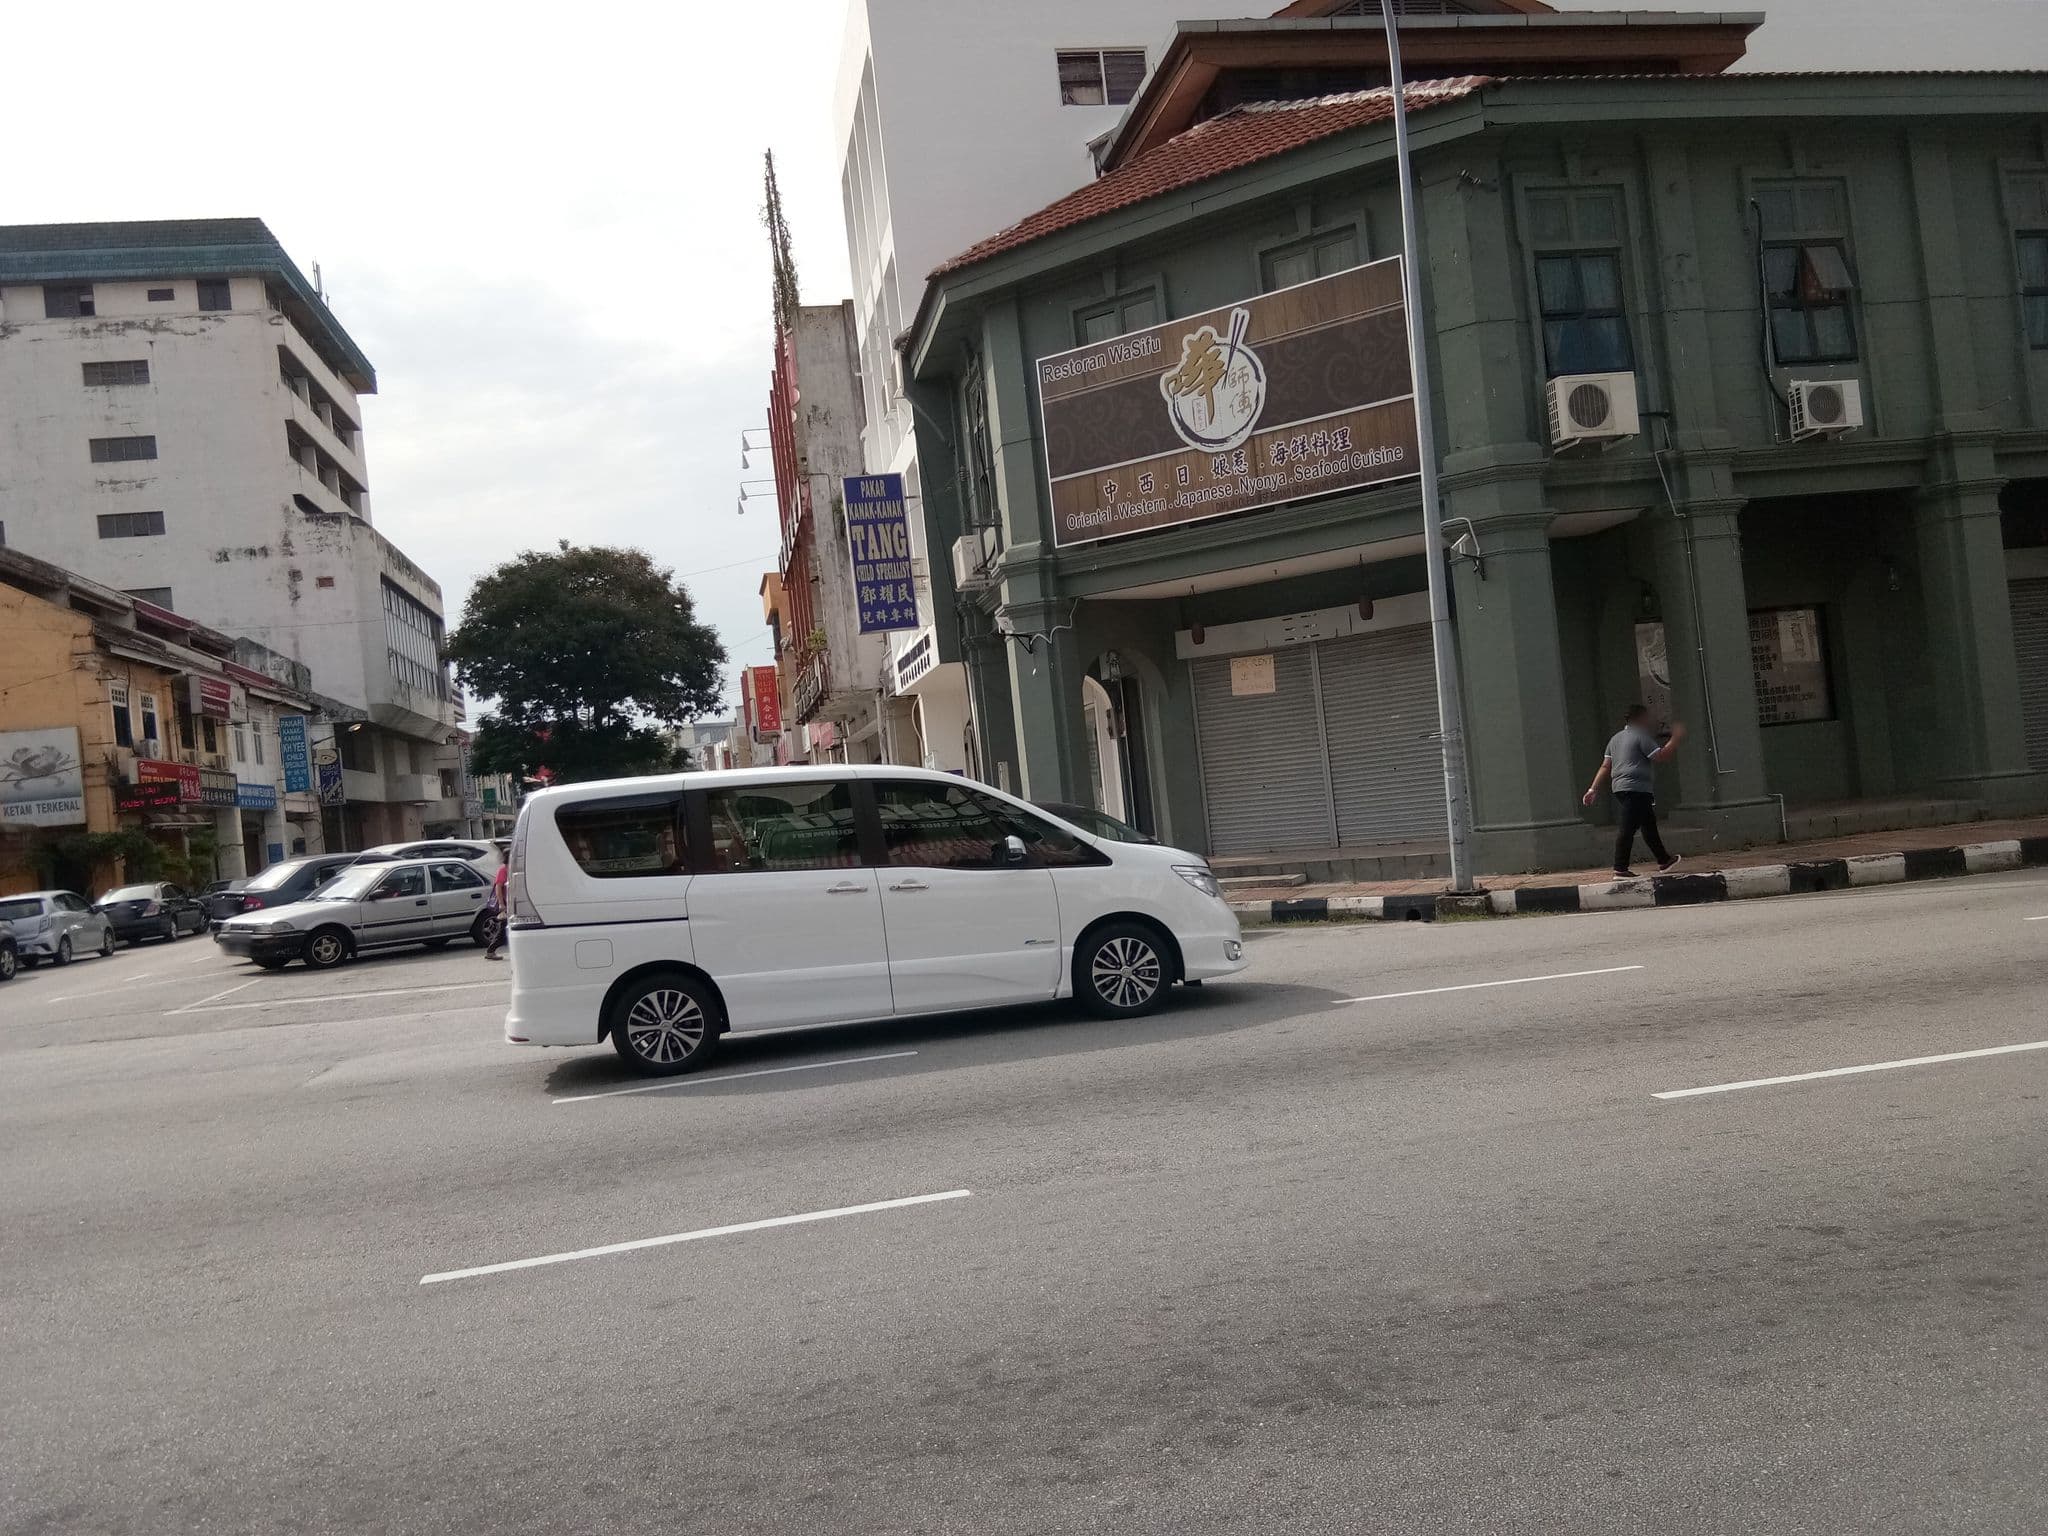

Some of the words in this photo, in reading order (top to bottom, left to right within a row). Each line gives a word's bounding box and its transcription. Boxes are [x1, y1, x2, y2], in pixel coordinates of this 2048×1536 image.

[1043, 353, 1107, 384] Restoran
[1108, 336, 1162, 366] WaSifu
[860, 479, 886, 499] PAKAR
[1067, 505, 1113, 531] Oriental
[1117, 497, 1168, 521] Western
[1175, 483, 1232, 509] Japanese
[1239, 470, 1288, 497] Nyonya
[1295, 453, 1349, 483] Seafood
[1350, 445, 1404, 471] Cuisine
[1103, 480, 1118, 503] 中
[1139, 472, 1154, 494] 西
[1176, 465, 1190, 486] 日
[849, 499, 903, 521] KANAK-KANAK
[851, 522, 908, 562] TANG
[857, 563, 874, 582] CHILD
[877, 561, 911, 581] SPECIALIST
[4, 805, 33, 818] KETAM
[36, 799, 81, 815] TERKENAL
